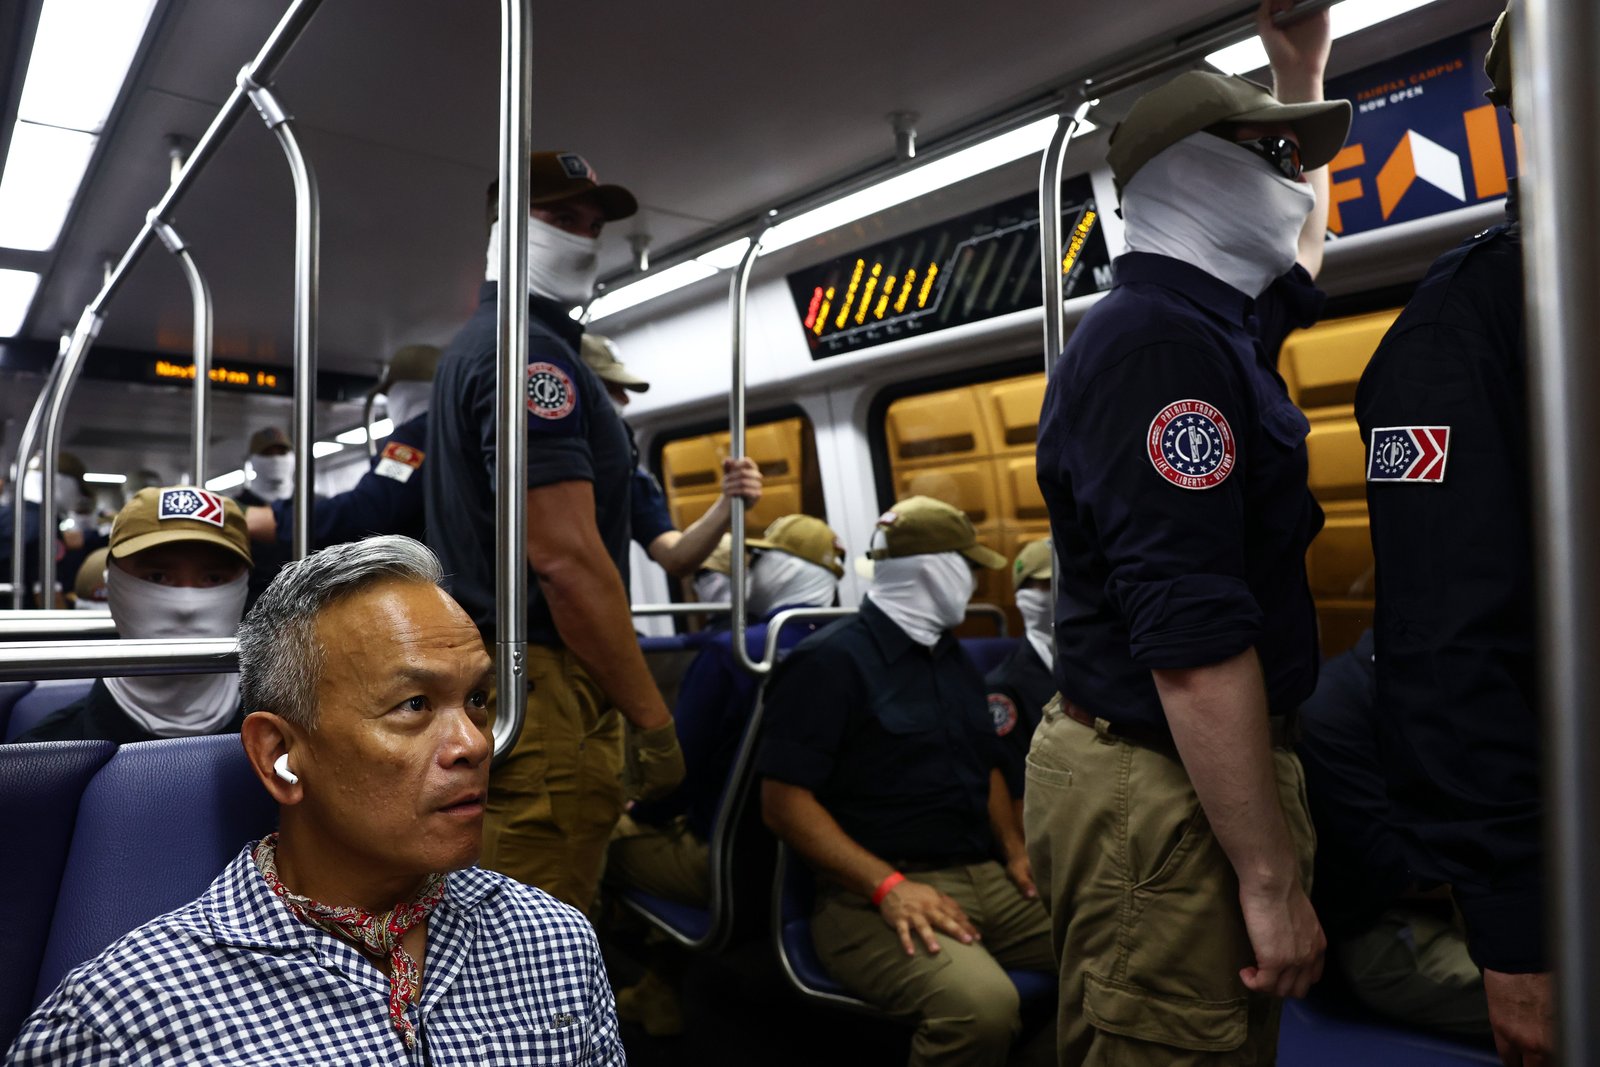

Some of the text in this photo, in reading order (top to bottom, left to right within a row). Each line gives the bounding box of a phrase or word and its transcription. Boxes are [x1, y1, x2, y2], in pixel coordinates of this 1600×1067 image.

[1357, 59, 1463, 102] FAIRFAX CAMPUS
[1359, 85, 1424, 113] NOW OPEN
[1160, 402, 1218, 423] PATRIOT FRONT
[1154, 453, 1233, 487] LIFE LIBERTY VICTORY
